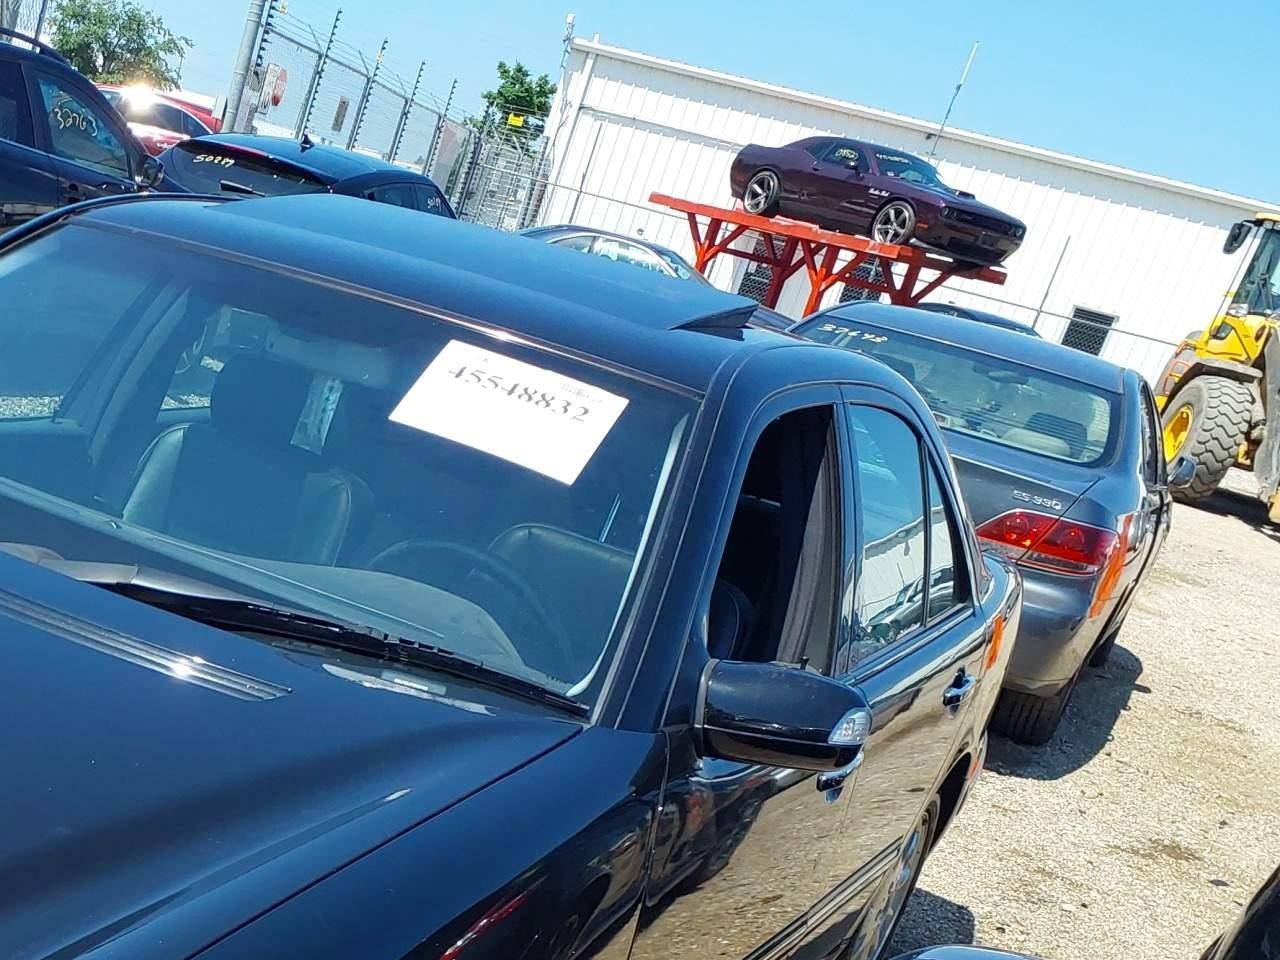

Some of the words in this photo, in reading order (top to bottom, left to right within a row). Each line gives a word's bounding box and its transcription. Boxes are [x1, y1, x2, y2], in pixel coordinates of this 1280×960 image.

[54, 108, 98, 137] 32763
[448, 366, 590, 423] 45548832
[1013, 489, 1032, 502] ES
[1032, 495, 1062, 510] 330
